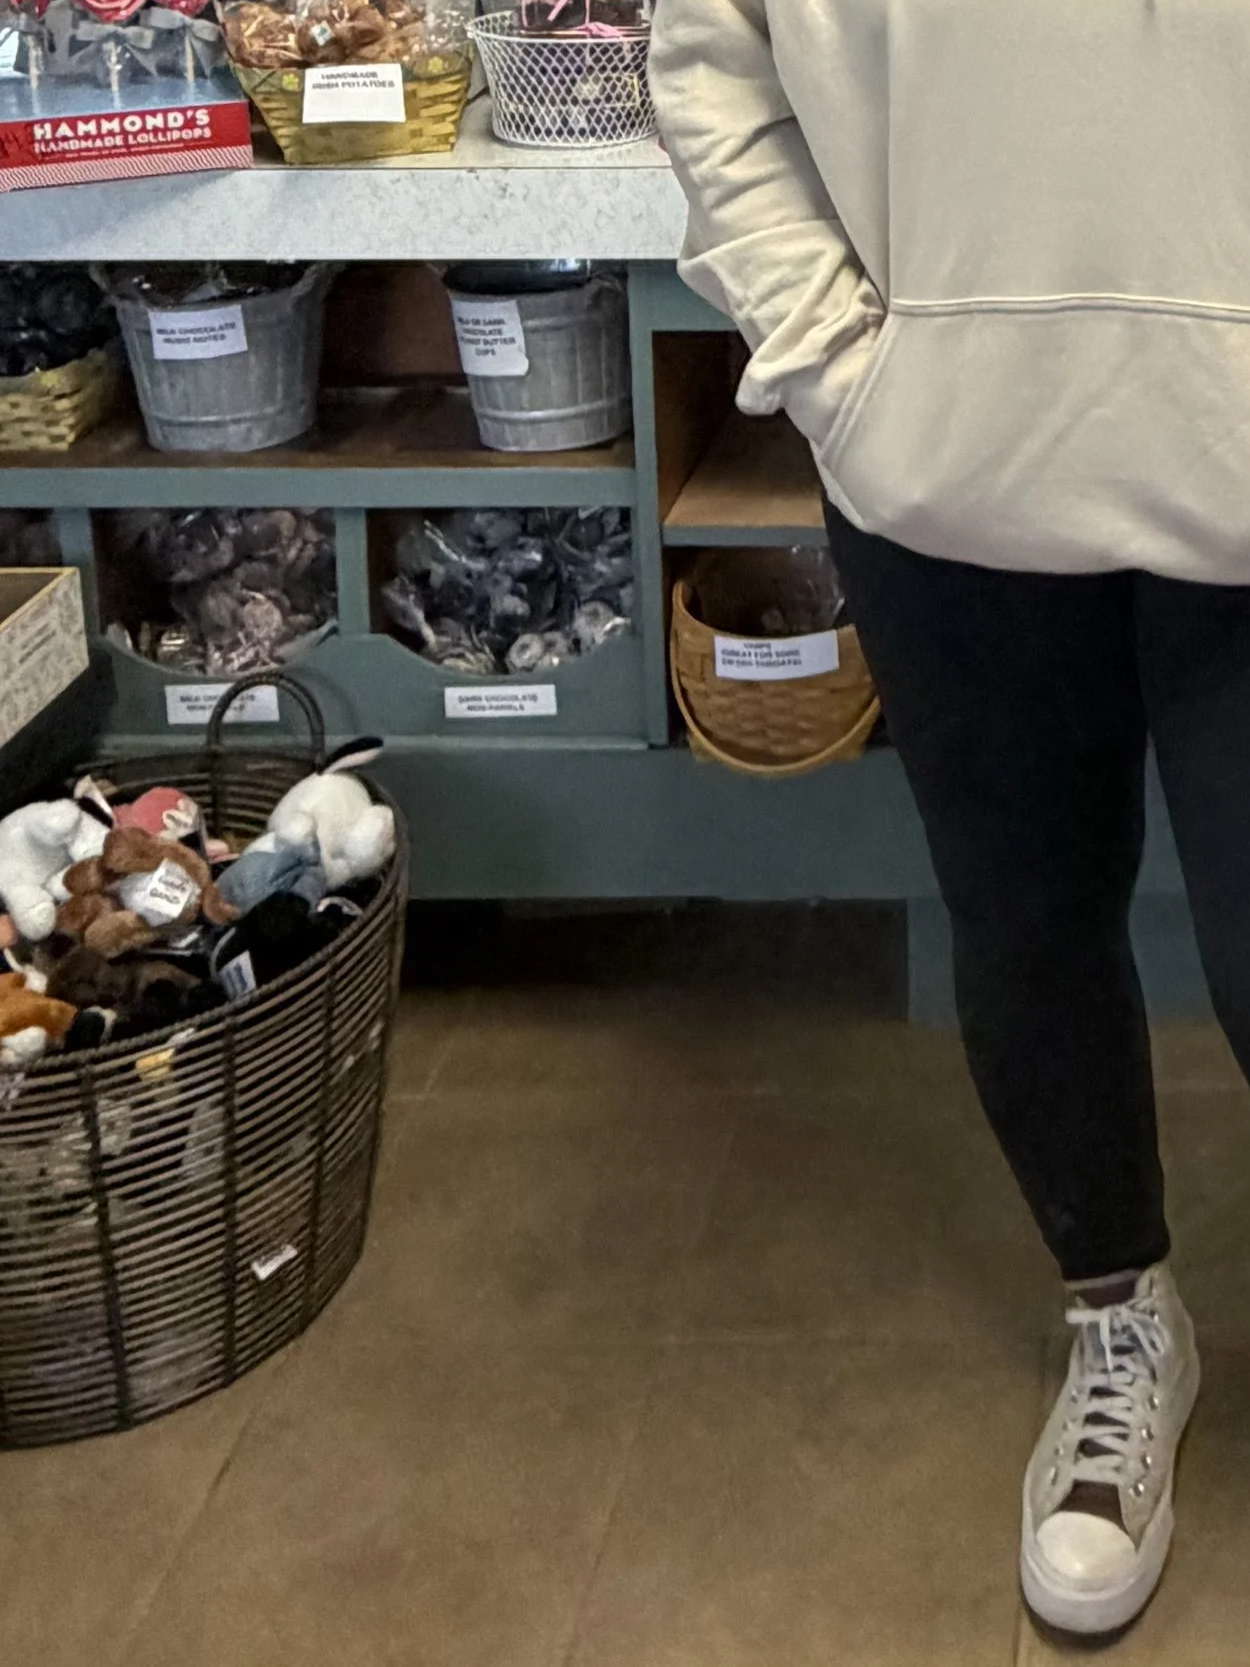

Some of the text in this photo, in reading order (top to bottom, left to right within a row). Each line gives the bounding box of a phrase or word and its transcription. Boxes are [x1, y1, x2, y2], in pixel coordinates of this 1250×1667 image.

[32, 108, 211, 140] HAMMOND'S
[33, 135, 125, 155] HANDMADE
[128, 126, 212, 146] LOLLIPOPS
